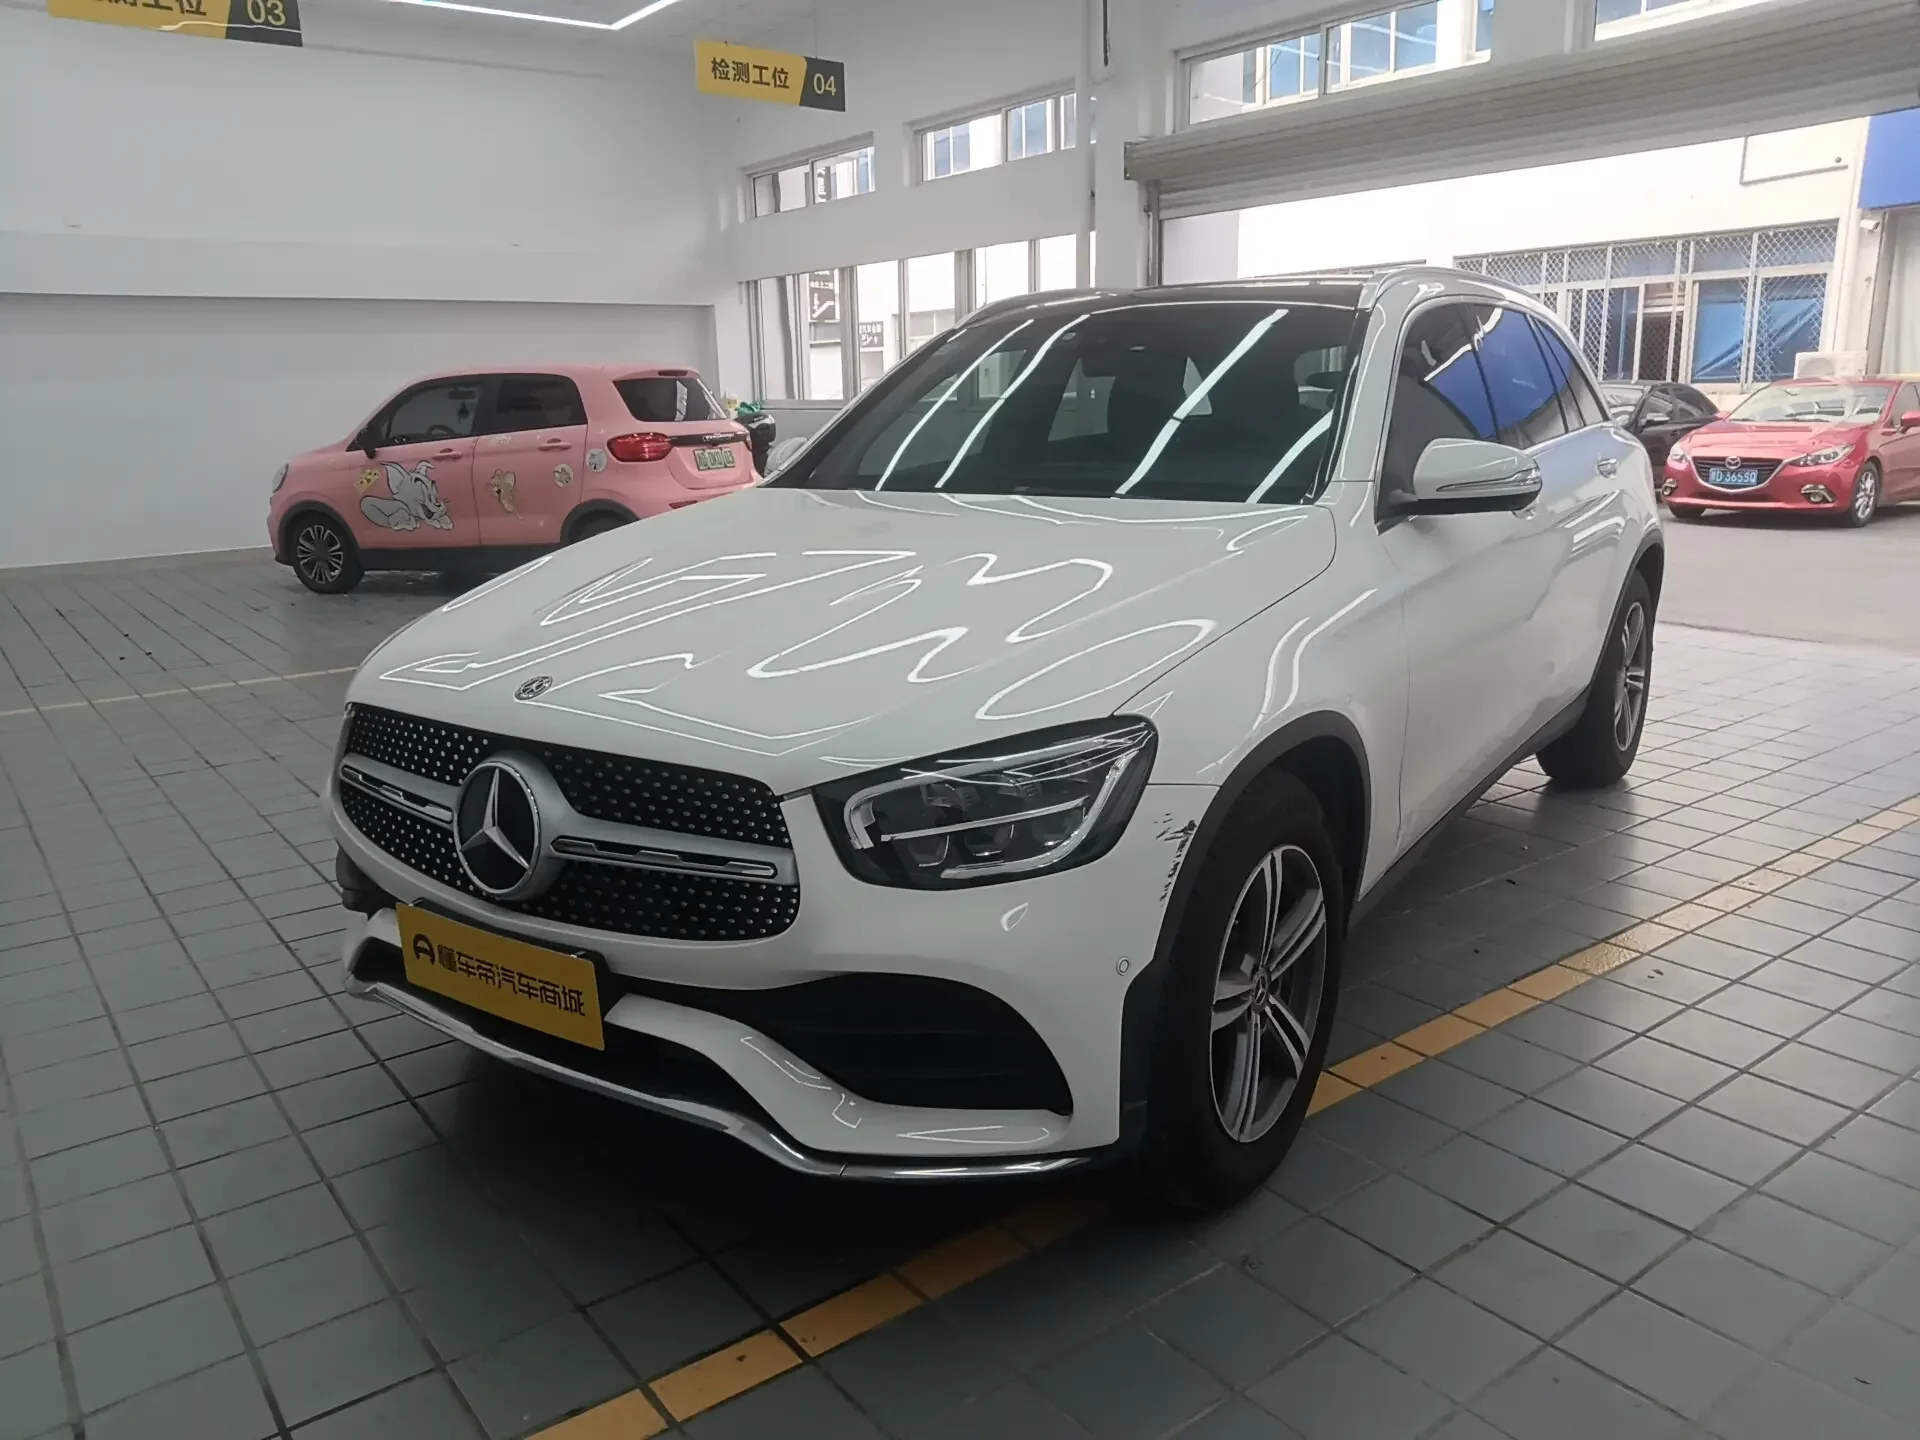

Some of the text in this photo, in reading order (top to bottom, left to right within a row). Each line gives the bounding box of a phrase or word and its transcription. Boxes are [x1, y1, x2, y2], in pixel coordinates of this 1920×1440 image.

[246, 0, 286, 26] 03
[711, 56, 836, 96] 检测工位 04
